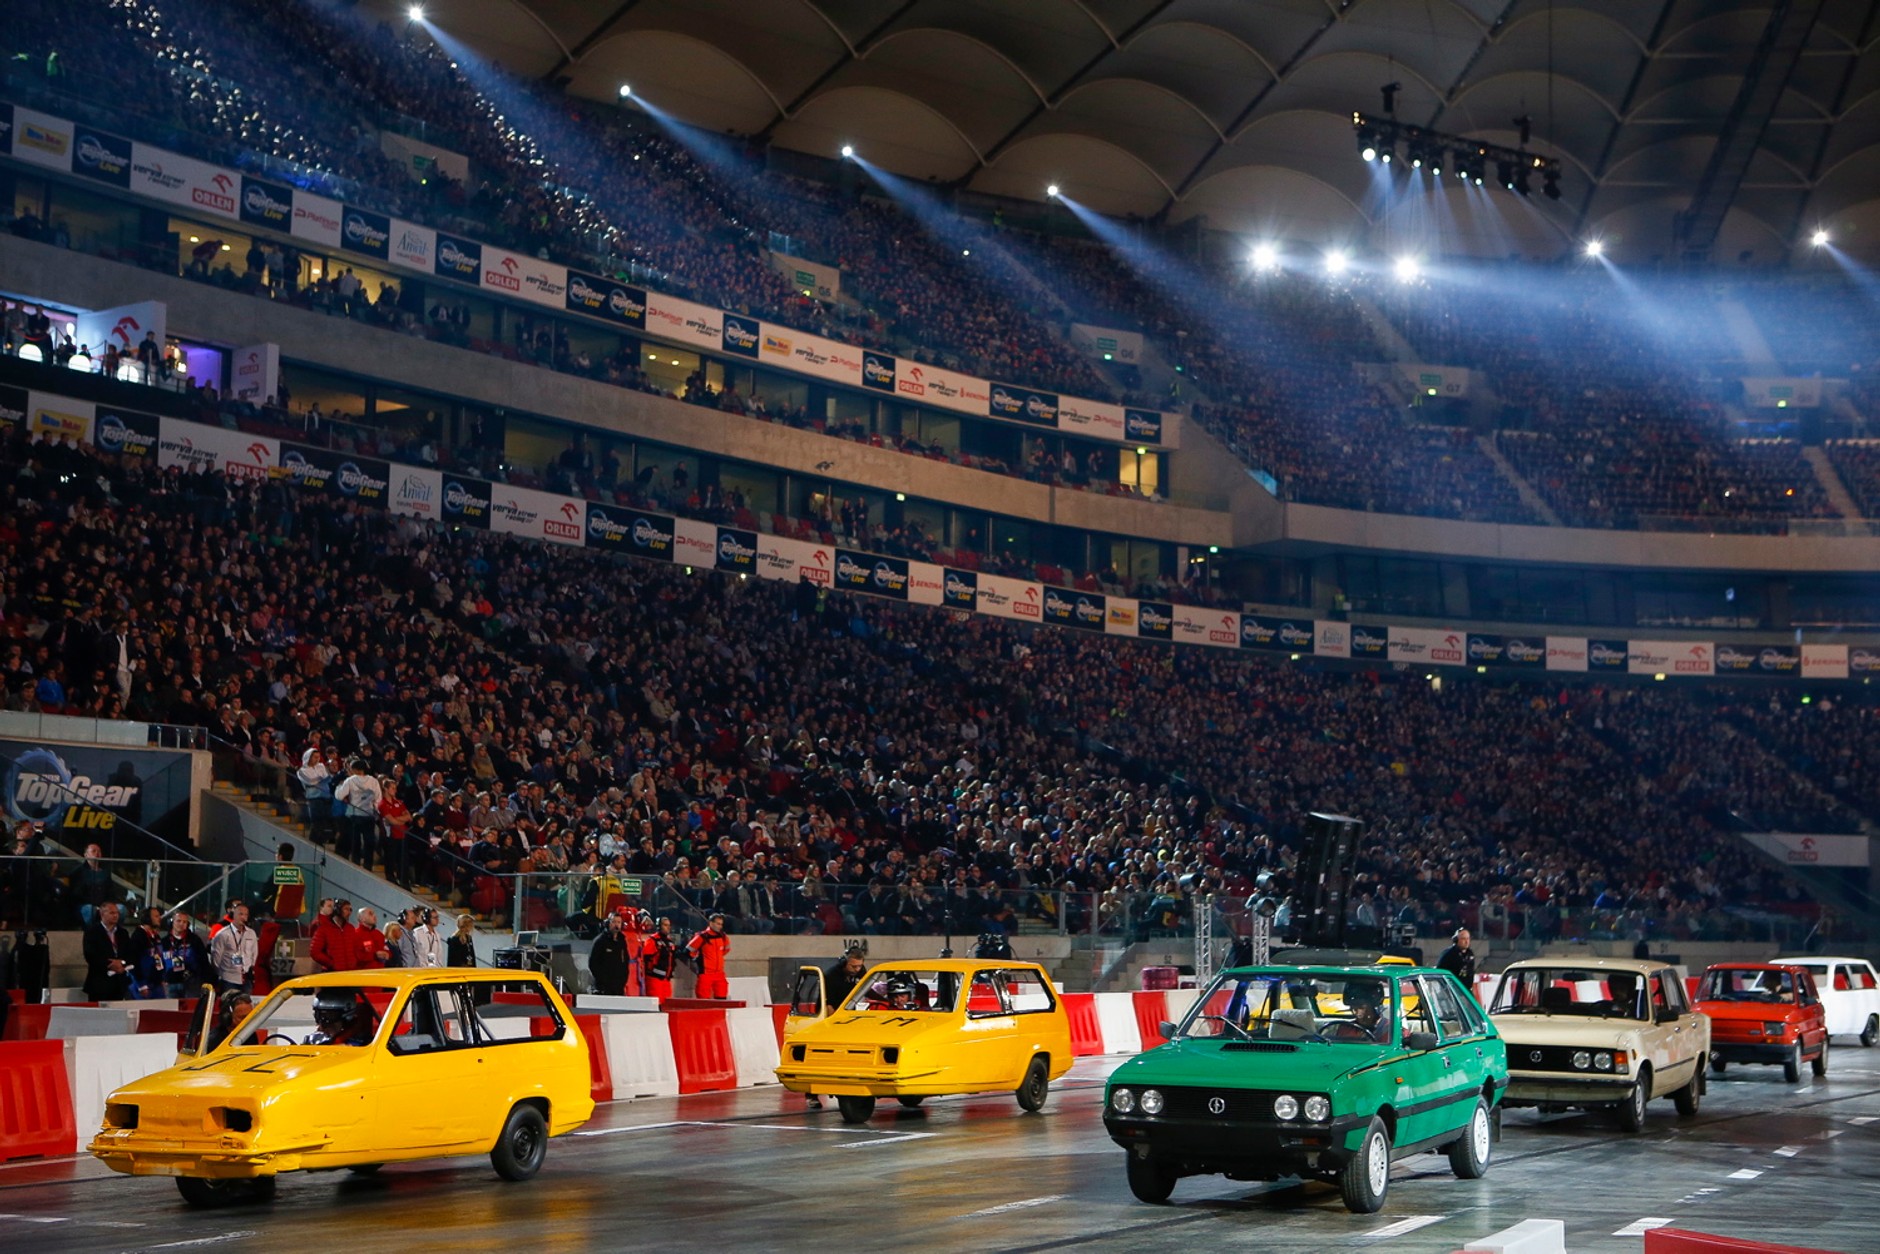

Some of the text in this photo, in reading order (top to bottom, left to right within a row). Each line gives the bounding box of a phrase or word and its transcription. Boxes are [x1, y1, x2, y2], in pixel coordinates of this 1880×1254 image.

[80, 142, 129, 167] TopGear
[99, 161, 121, 174] Live
[194, 189, 233, 211] ORLEN
[247, 191, 290, 213] TopGear
[264, 208, 284, 221] Live
[348, 221, 388, 241] TopGear
[363, 237, 381, 248] Live
[442, 247, 480, 267] TopGear
[456, 262, 473, 273] Live
[487, 272, 519, 290] ORLEN
[526, 275, 548, 288] verva
[571, 284, 606, 302] TopGear
[584, 297, 600, 308] Live
[612, 295, 645, 313] TopGear
[624, 308, 640, 319] Live
[727, 327, 758, 343] TopGear
[739, 338, 753, 348] Live
[102, 425, 155, 445] TopGear
[123, 442, 147, 455] Live
[161, 440, 218, 459] verva street
[285, 460, 333, 479] TopGear
[303, 476, 325, 488] Live
[340, 471, 387, 490] TopGear
[358, 486, 379, 498] Live
[397, 477, 431, 501] Anwil
[446, 490, 489, 509] TopGear
[463, 505, 481, 517] Live
[492, 504, 517, 515] verva
[545, 521, 578, 538] ORLEN
[591, 517, 628, 534] TopGear
[605, 531, 623, 541] Live
[635, 525, 672, 543] TopGear
[650, 539, 667, 550] Live
[687, 537, 714, 548] Platinum
[720, 541, 755, 556] TopGear
[735, 554, 750, 563] Live
[757, 552, 778, 563] verva
[801, 567, 829, 581] ORLEN
[838, 563, 871, 577] TopGear
[876, 568, 906, 582] TopGear
[851, 575, 866, 583] Live
[888, 581, 902, 589] Live
[1014, 603, 1038, 616] ORLEN
[1210, 631, 1235, 643] ORLEN
[16, 772, 139, 809] TopGear
[63, 805, 117, 830] Live
[271, 959, 295, 973] S27
